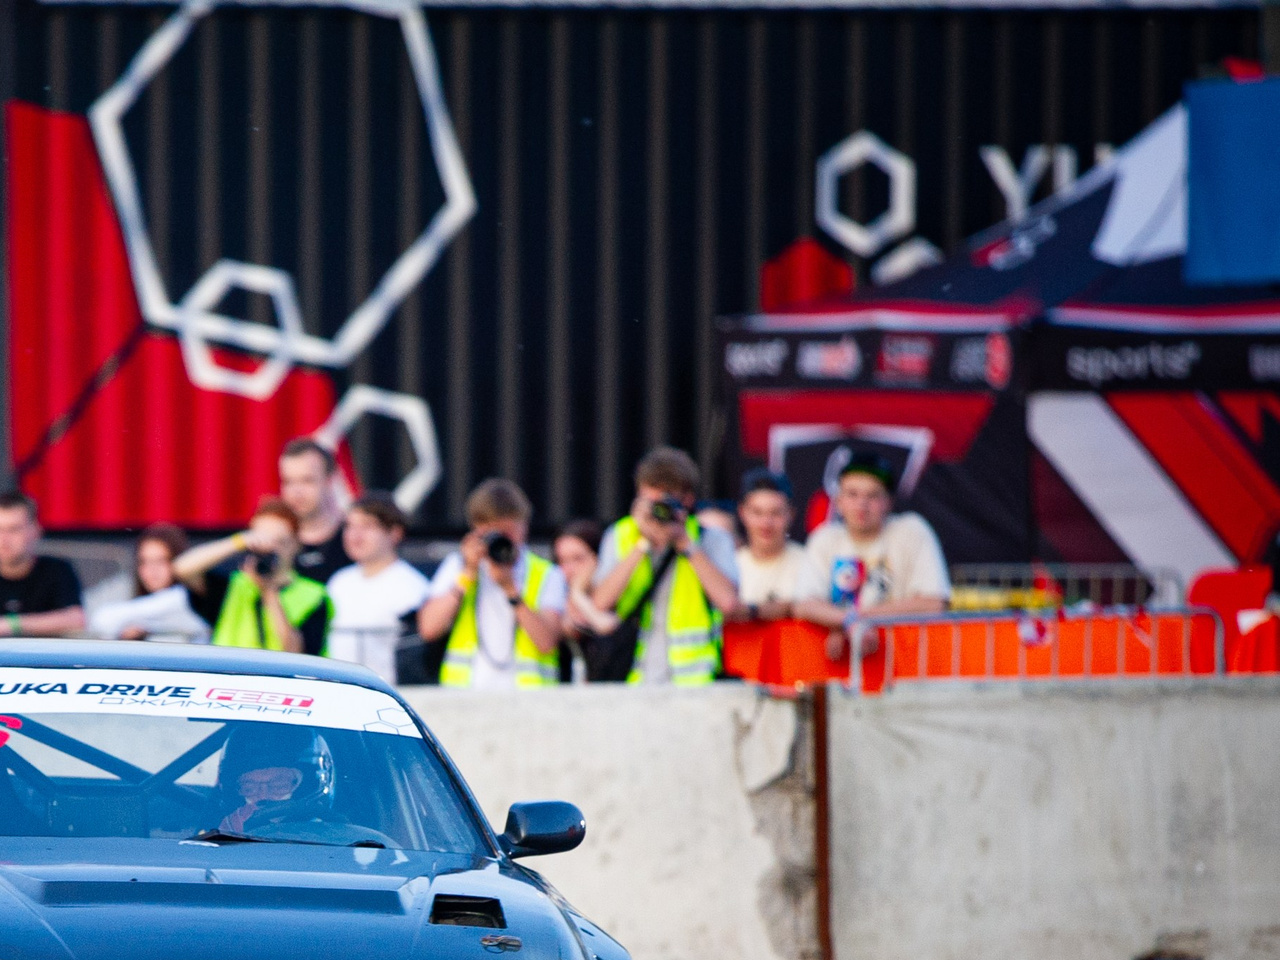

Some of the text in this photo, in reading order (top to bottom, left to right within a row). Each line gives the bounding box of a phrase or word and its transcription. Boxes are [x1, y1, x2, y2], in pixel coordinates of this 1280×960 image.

[77, 683, 196, 698] DRIVE
[207, 688, 314, 708] FEST
[98, 697, 312, 717] ДЖИМХАНА
